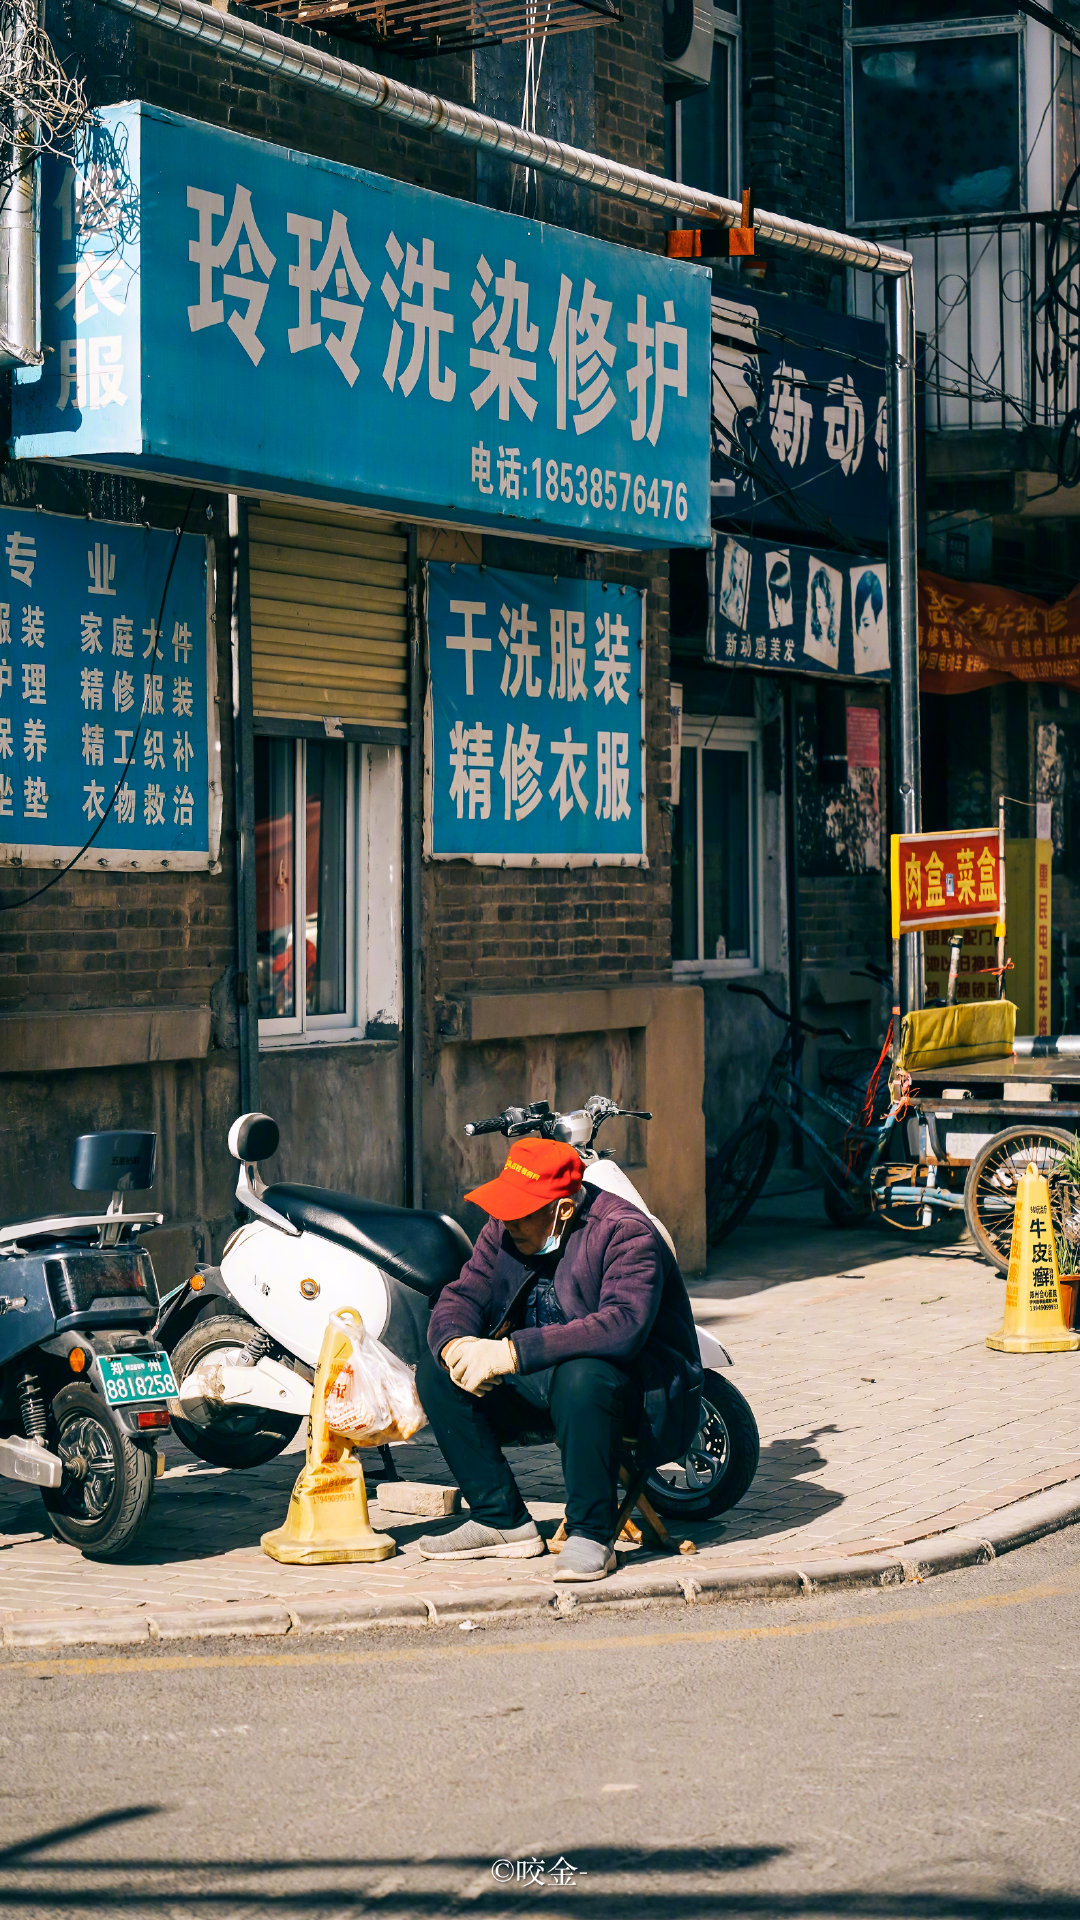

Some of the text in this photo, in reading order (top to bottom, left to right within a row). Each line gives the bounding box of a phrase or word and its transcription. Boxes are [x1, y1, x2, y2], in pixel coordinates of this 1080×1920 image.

[186, 183, 688, 447] 玲玲洗染修护
[769, 358, 888, 477] 新动
[471, 440, 689, 521] 电话:18538576476
[80, 611, 193, 664] 家庭大件
[446, 599, 632, 706] 干洗服装
[725, 631, 796, 662] 新动感美发
[80, 666, 194, 718] 精修服装
[81, 722, 195, 774] 精工织补
[449, 720, 632, 822] 精修衣服
[82, 778, 195, 827] 衣物救治
[905, 846, 996, 910] 肉盒 菜盒
[963, 928, 1008, 947] 配门
[1030, 1218, 1049, 1287] 牛皮癣
[106, 1373, 176, 1400] 8818258
[110, 1361, 125, 1376] 郑
[147, 1359, 162, 1372] 州
